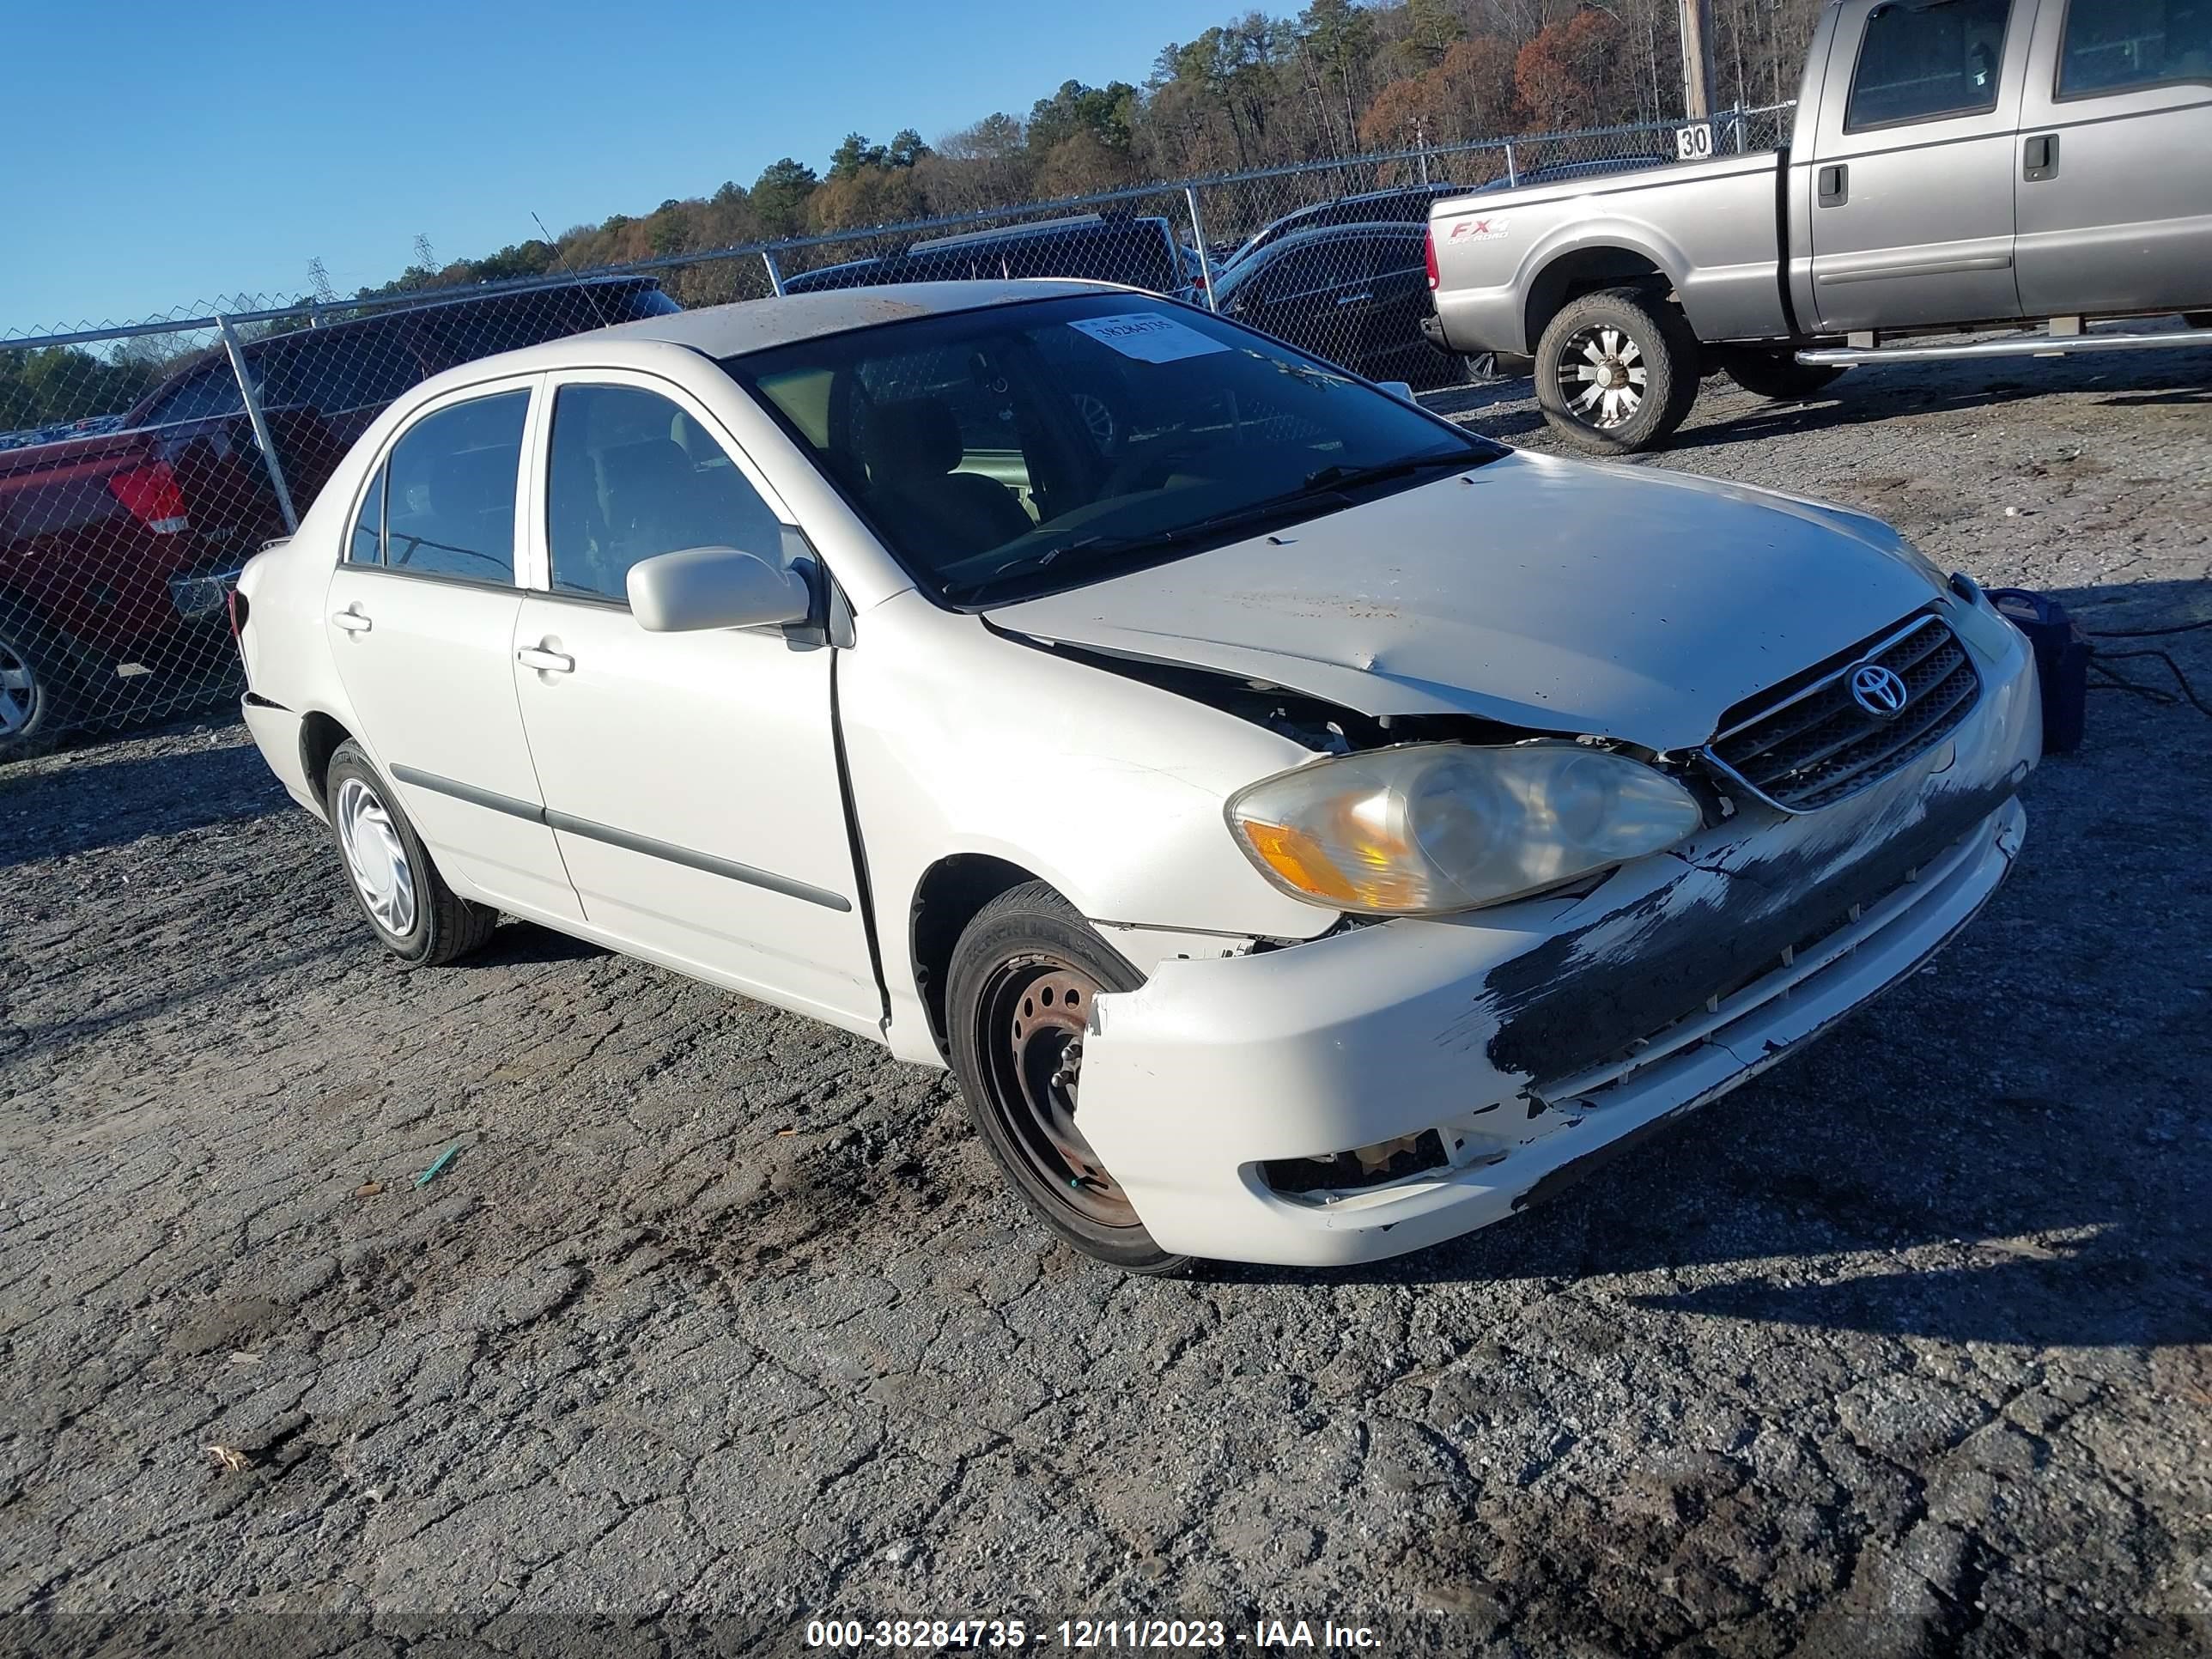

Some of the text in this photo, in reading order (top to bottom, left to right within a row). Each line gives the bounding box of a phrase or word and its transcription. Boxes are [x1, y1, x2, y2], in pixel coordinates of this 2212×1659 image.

[1682, 127, 1707, 156] 30
[1451, 218, 1510, 237] FX4
[1474, 232, 1508, 242] ROAD
[1095, 320, 1176, 338] 38284735
